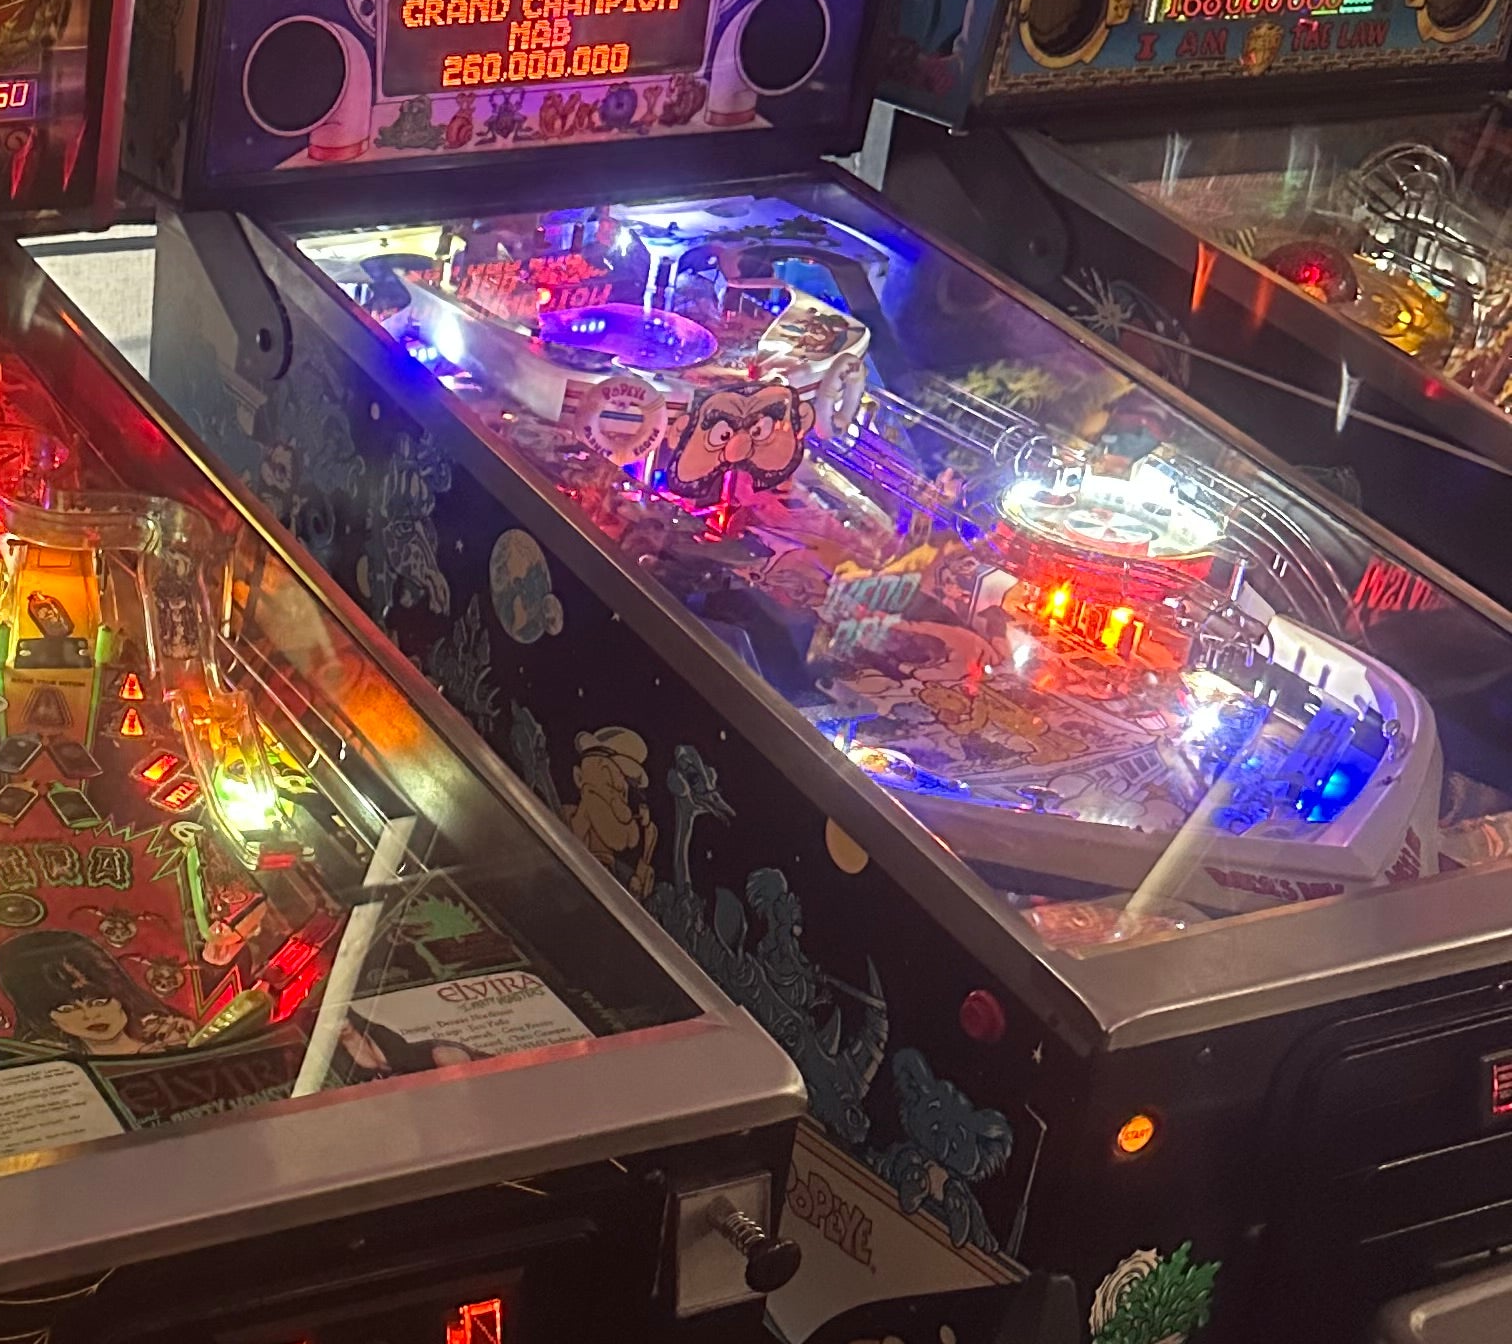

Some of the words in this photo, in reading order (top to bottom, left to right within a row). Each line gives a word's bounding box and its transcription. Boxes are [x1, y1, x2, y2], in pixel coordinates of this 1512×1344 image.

[509, 17, 572, 52] MAB
[436, 974, 545, 1004] ELVIRA
[787, 1168, 874, 1267] OPEYE
